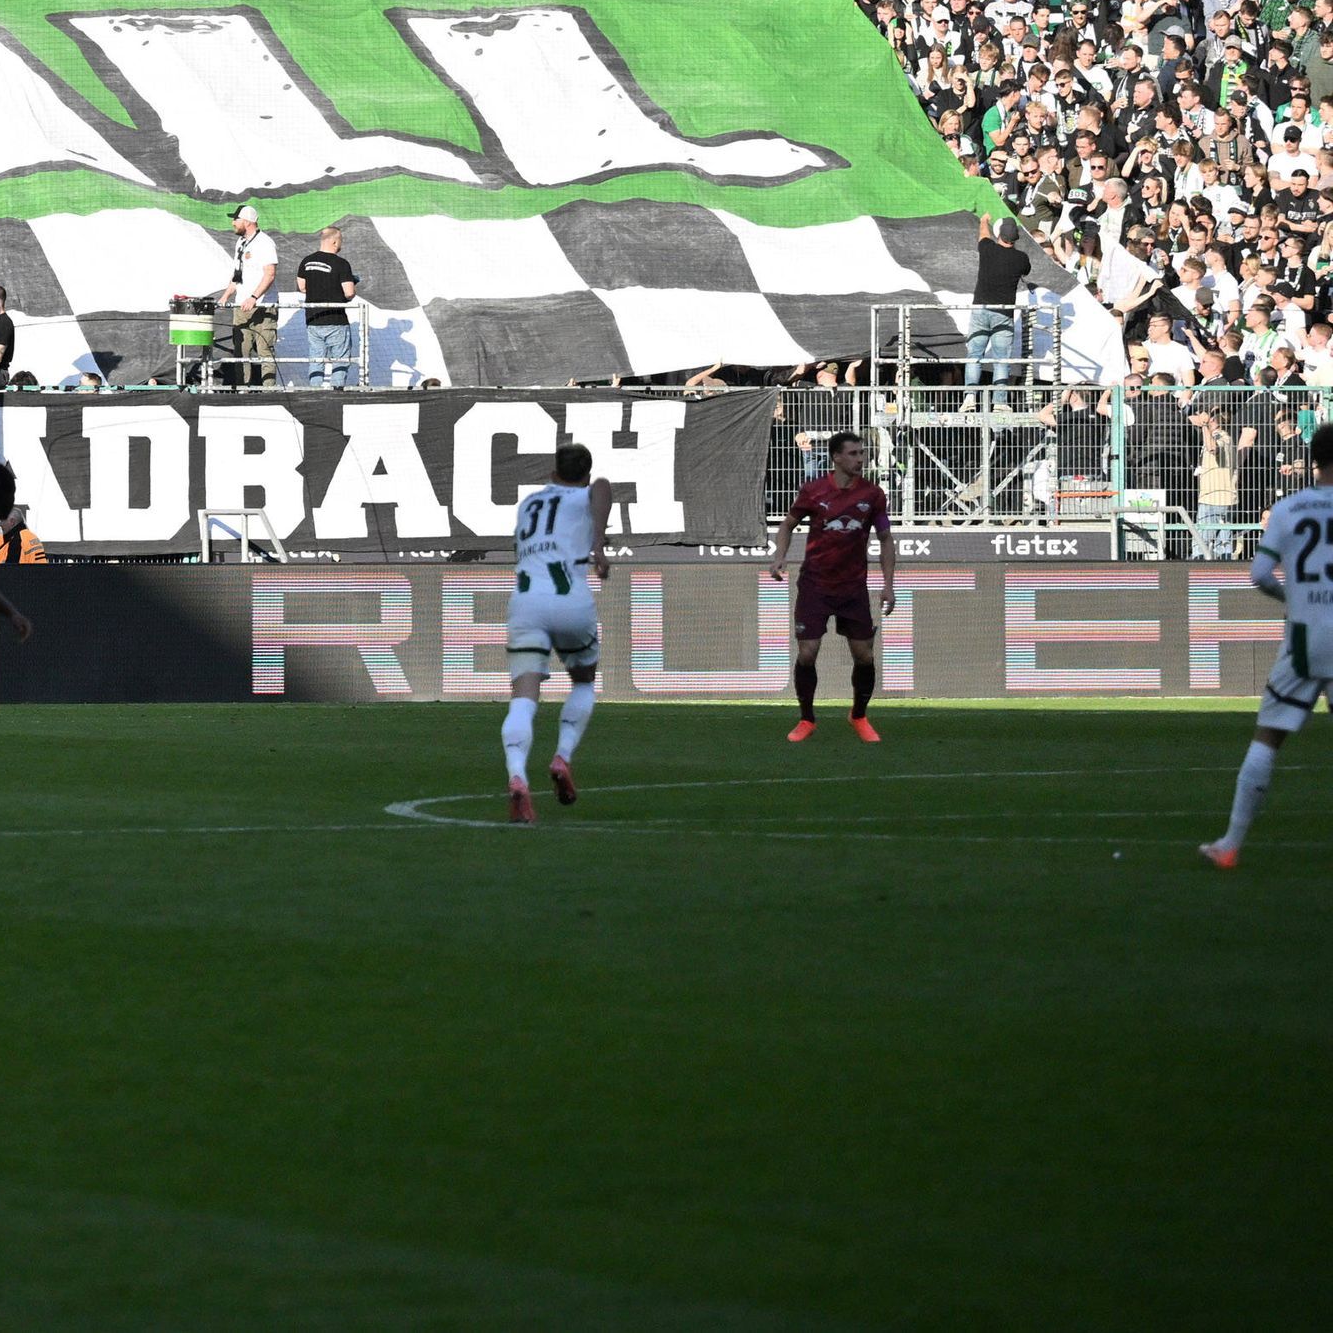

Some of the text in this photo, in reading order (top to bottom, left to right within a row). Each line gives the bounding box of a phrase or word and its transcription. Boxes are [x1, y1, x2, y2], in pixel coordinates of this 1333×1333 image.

[520, 496, 562, 541] 31
[867, 537, 931, 556] atex
[990, 534, 1079, 556] flatex
